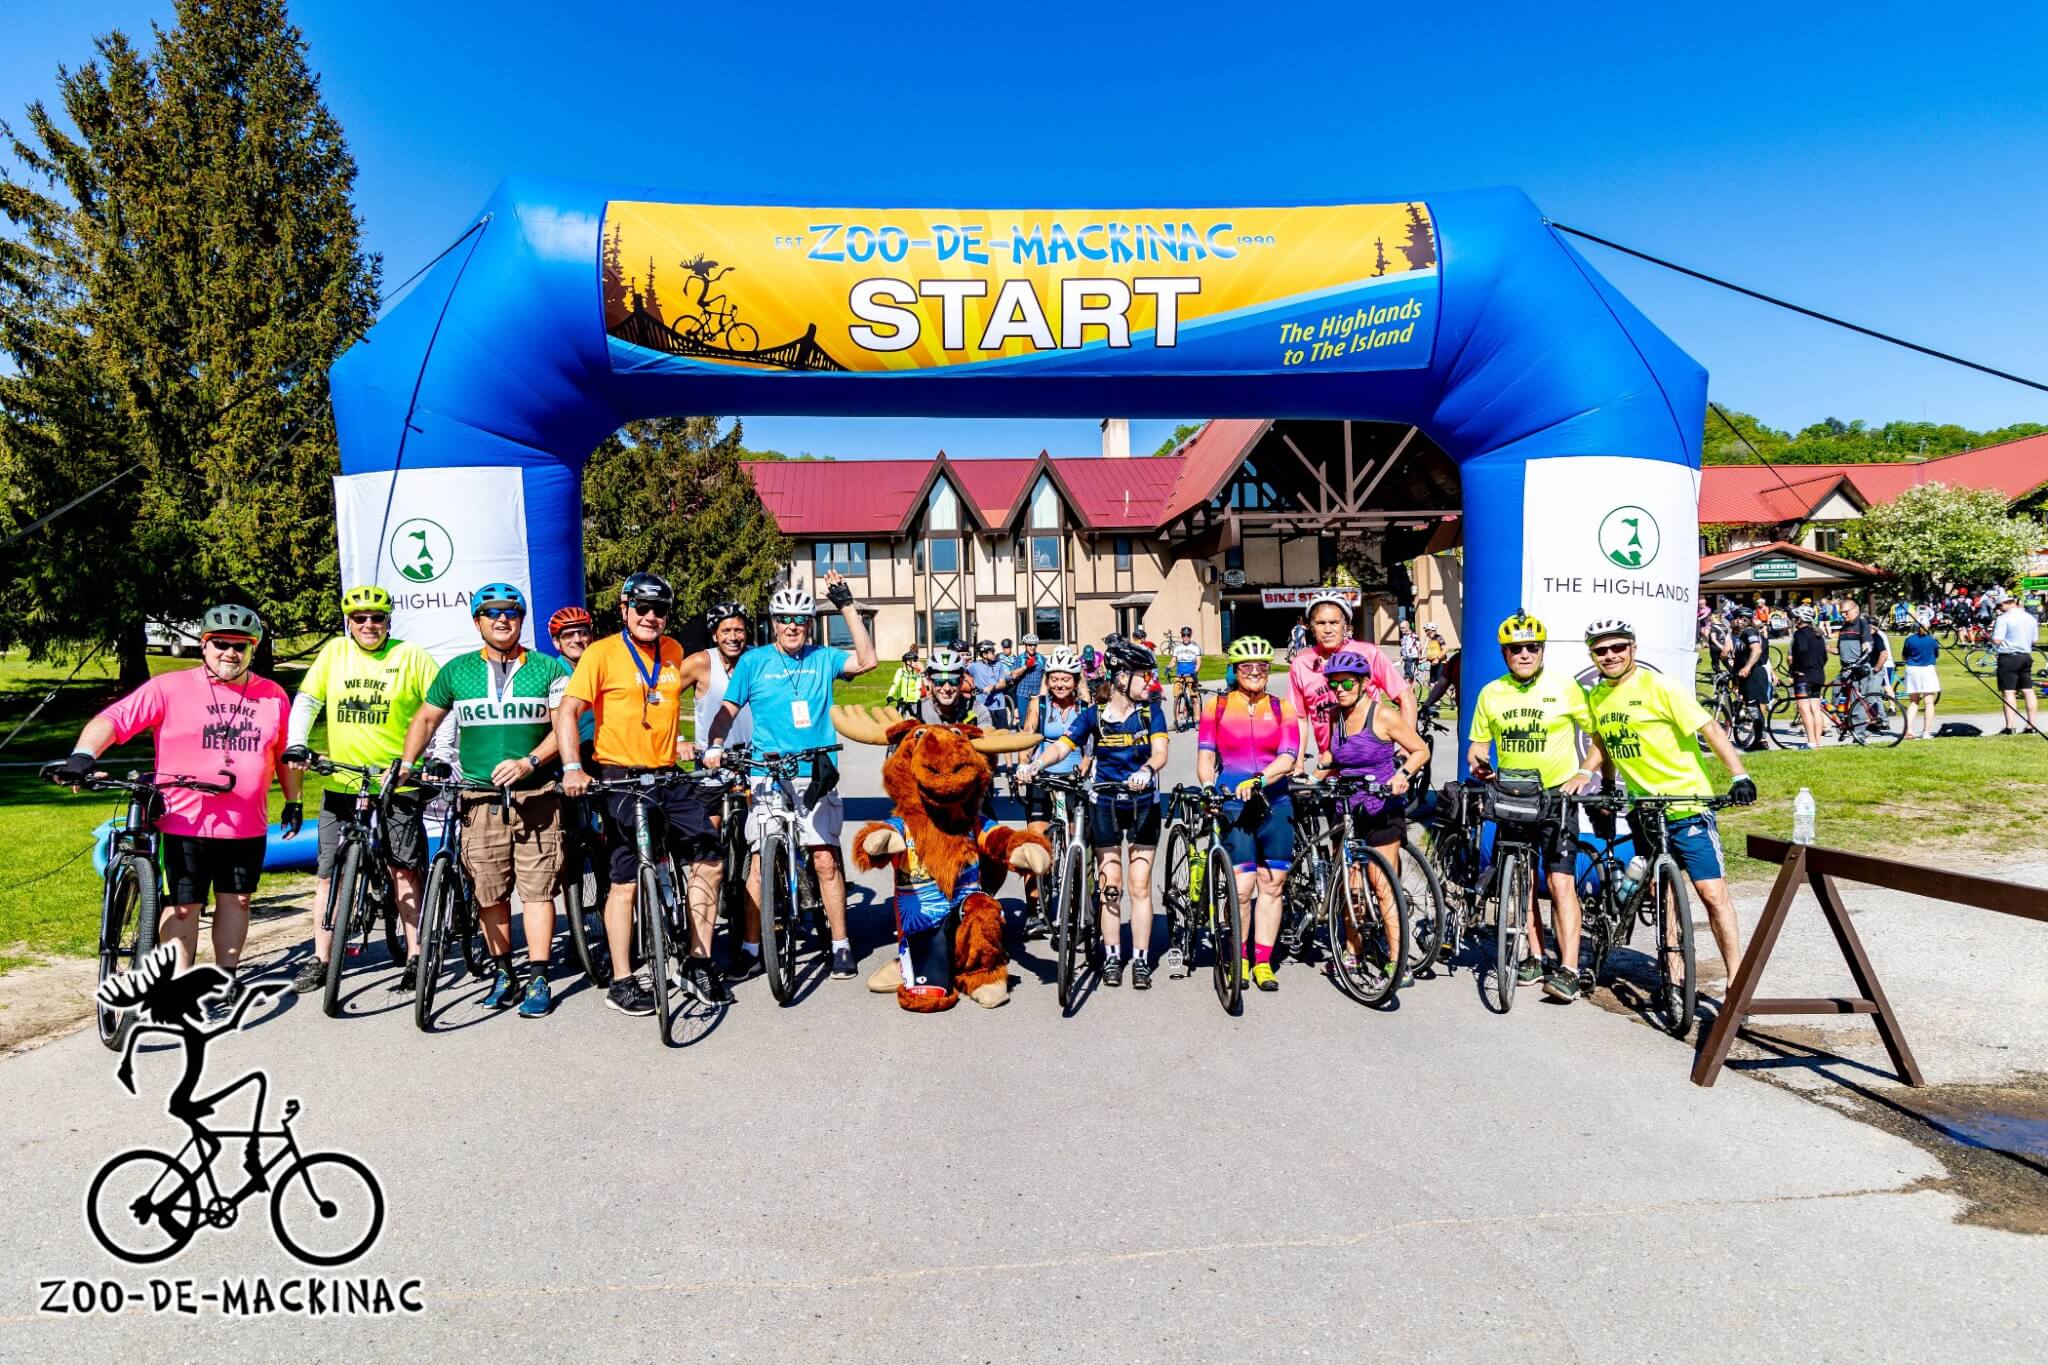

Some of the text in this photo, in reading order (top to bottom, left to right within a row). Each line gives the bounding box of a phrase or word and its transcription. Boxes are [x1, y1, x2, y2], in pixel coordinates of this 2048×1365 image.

[807, 221, 1240, 265] ZOO-DE-MACKINAC
[1237, 235, 1276, 248] 1990
[847, 276, 1201, 352] START
[1279, 298, 1422, 345] The Highlands
[1283, 321, 1416, 366] to The Island
[1264, 592, 1295, 604] BIKE
[1543, 577, 1690, 603] THE HIGHLANDS
[392, 592, 475, 610] HIGHLA
[343, 679, 388, 692] WE BIKE
[206, 703, 257, 719] WE BIKE
[336, 709, 390, 724] DETROIT
[458, 702, 547, 721] IRELAND
[1502, 708, 1545, 721] WE BIKE
[1599, 711, 1630, 727] WE BIKE
[202, 735, 261, 752] DETROIT
[1501, 739, 1547, 753] DETROIT
